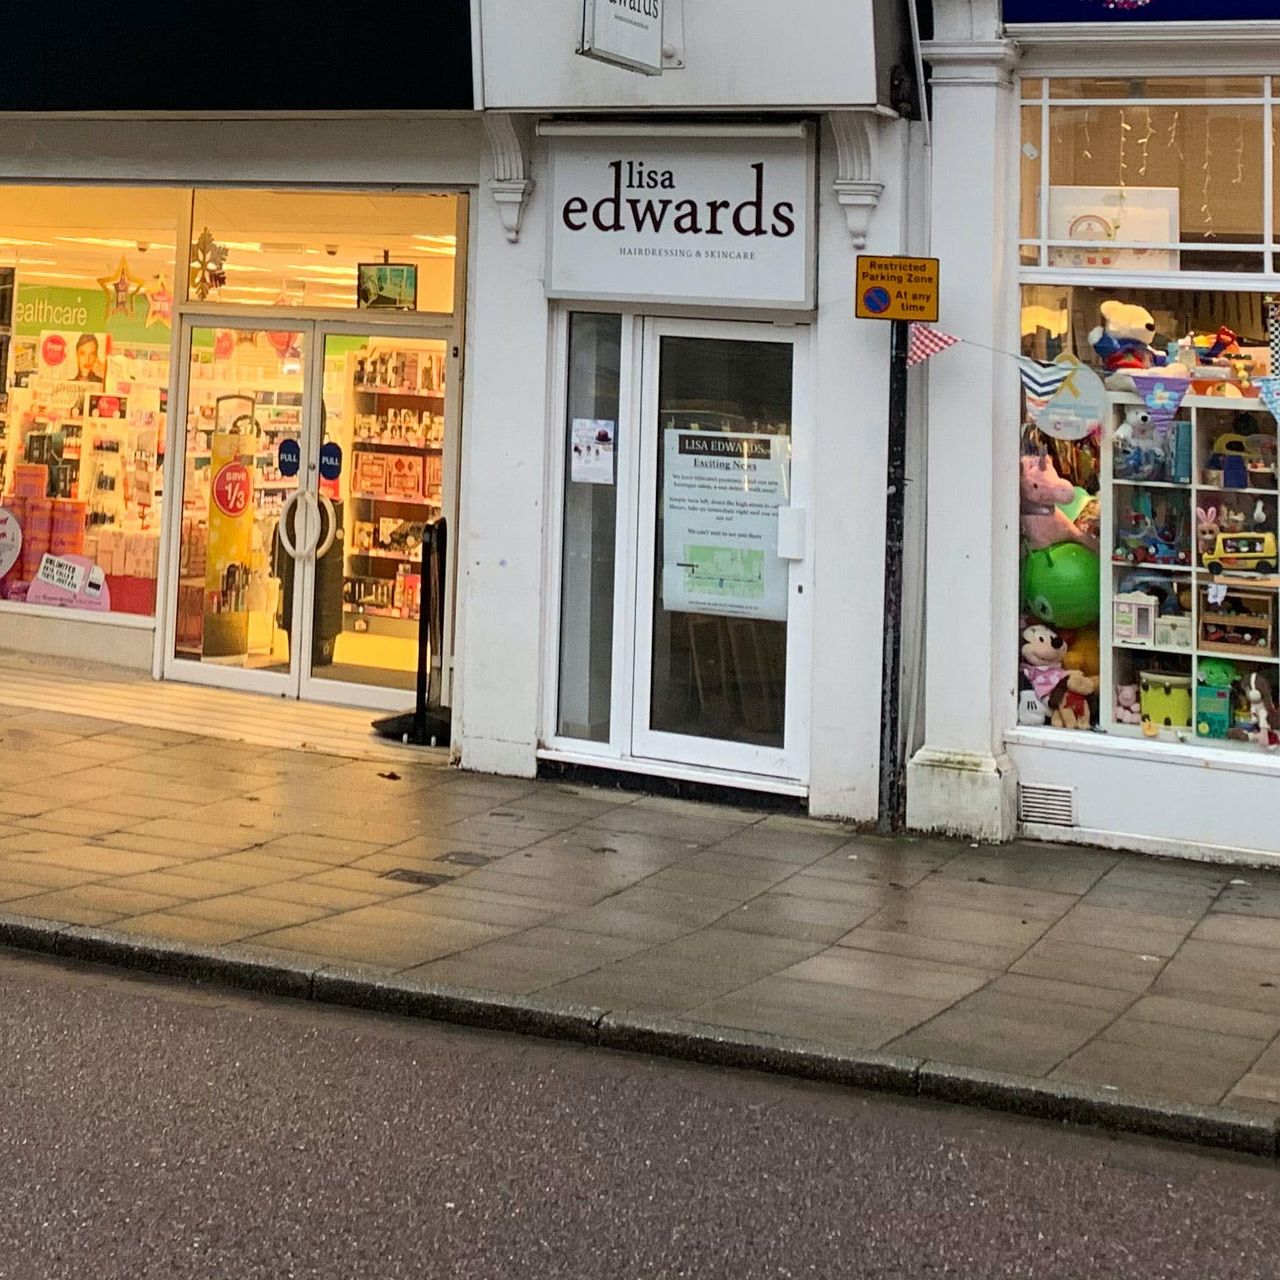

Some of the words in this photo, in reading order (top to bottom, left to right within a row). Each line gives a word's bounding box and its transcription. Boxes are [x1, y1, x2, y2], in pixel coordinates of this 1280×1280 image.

[625, 161, 676, 189] lisa
[562, 160, 795, 238] edwards
[619, 247, 693, 258] HAIRDRESSING
[695, 250, 702, 258] &
[704, 250, 756, 260] SKINCARE
[869, 261, 926, 272] Restricted
[862, 272, 903, 284] Parking
[907, 273, 933, 283] Zone
[896, 291, 907, 300] At
[912, 293, 931, 302] any
[16, 298, 87, 325] ealthcare
[901, 303, 926, 312] time
[685, 439, 708, 451] LISA
[711, 440, 765, 454] EDWADS
[280, 454, 298, 462] PULL
[322, 456, 338, 466] PULL
[694, 458, 731, 470] Exciting
